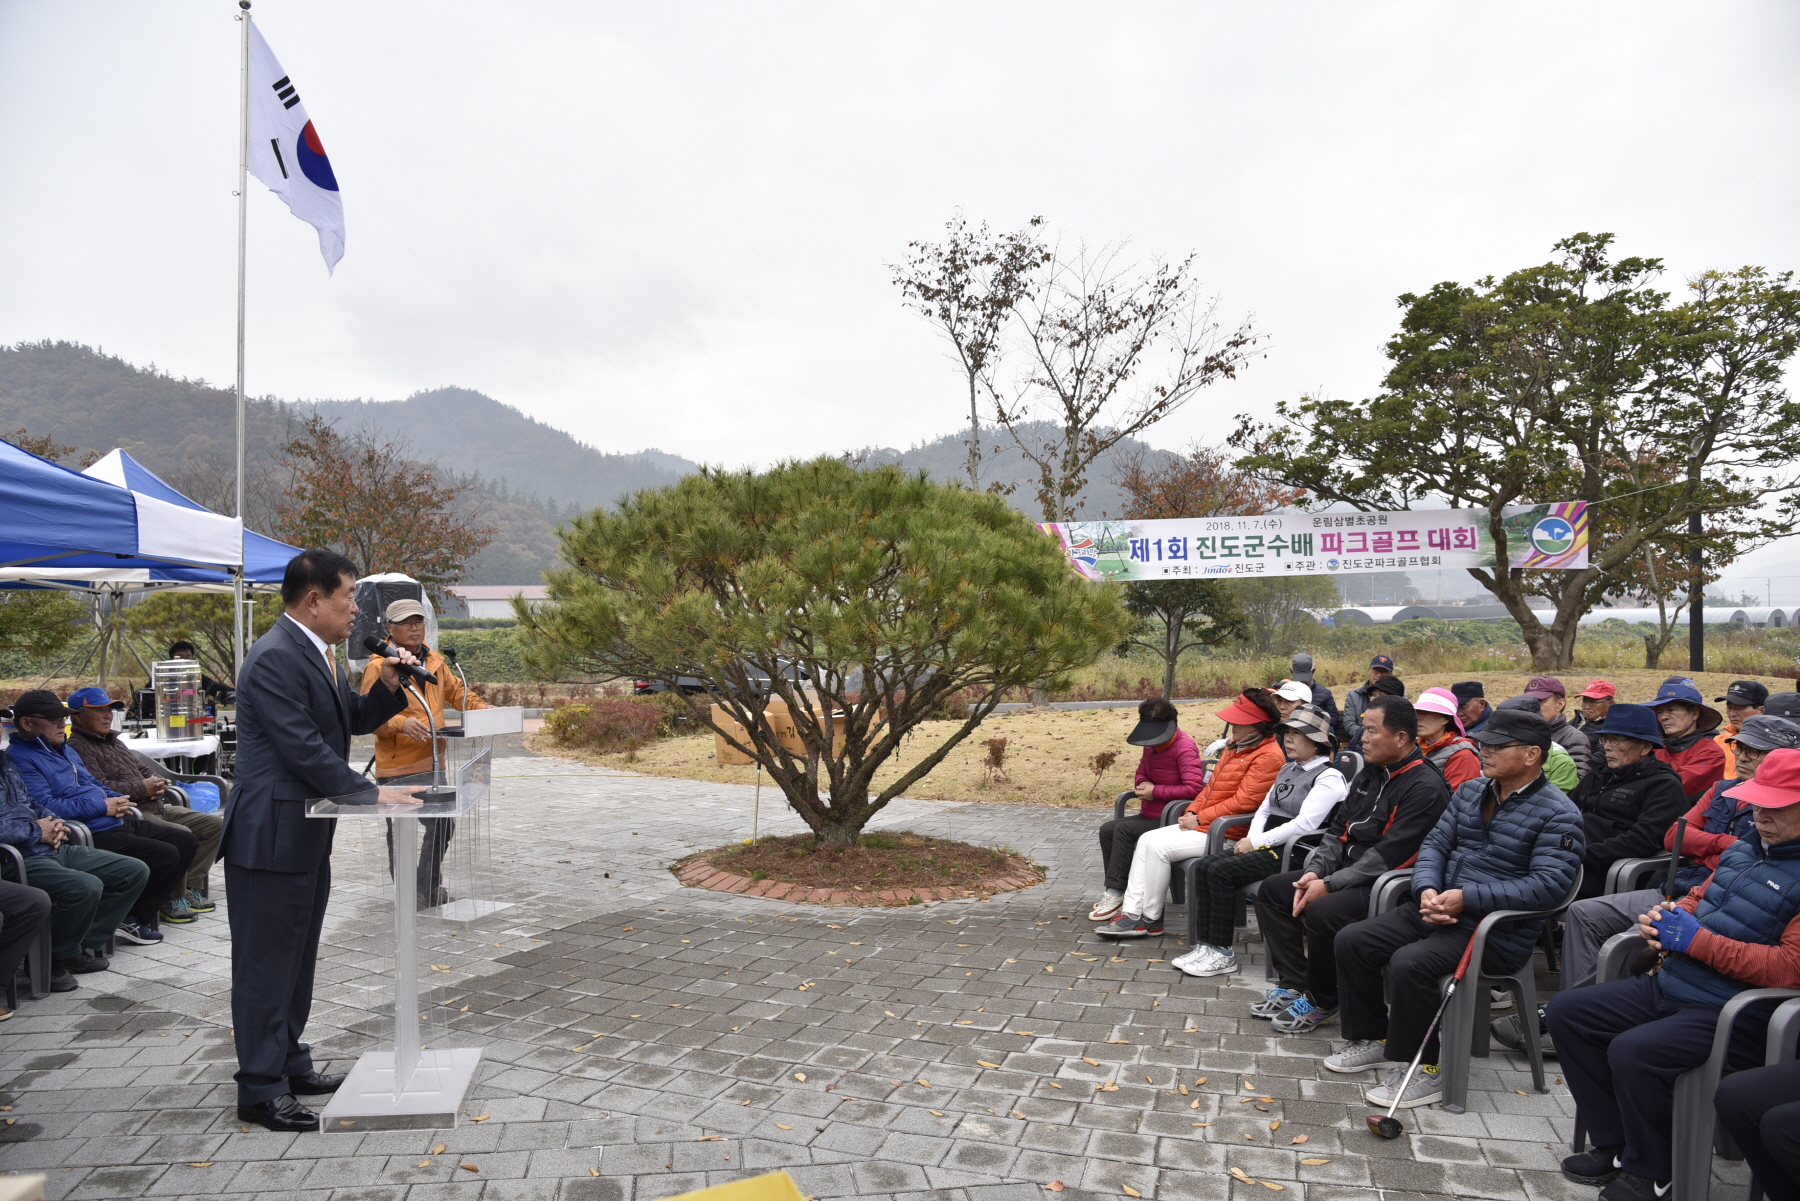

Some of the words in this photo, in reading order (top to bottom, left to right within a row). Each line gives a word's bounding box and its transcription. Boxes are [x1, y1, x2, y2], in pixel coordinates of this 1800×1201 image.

[1206, 521, 1234, 531] 2018.
[1238, 520, 1252, 530] 11.
[1311, 514, 1388, 528] 운림삼별초공원
[1129, 536, 1188, 562] 제1회
[1196, 532, 1314, 560] 진도군수배
[1320, 529, 1421, 556] 파크골프
[1428, 526, 1477, 551] 대회
[1171, 565, 1192, 576] 주최
[1234, 562, 1265, 574] 진도군
[1294, 560, 1316, 572] 주관
[1342, 555, 1442, 570] 진도군파크골프협회
[1766, 879, 1781, 891] PING
